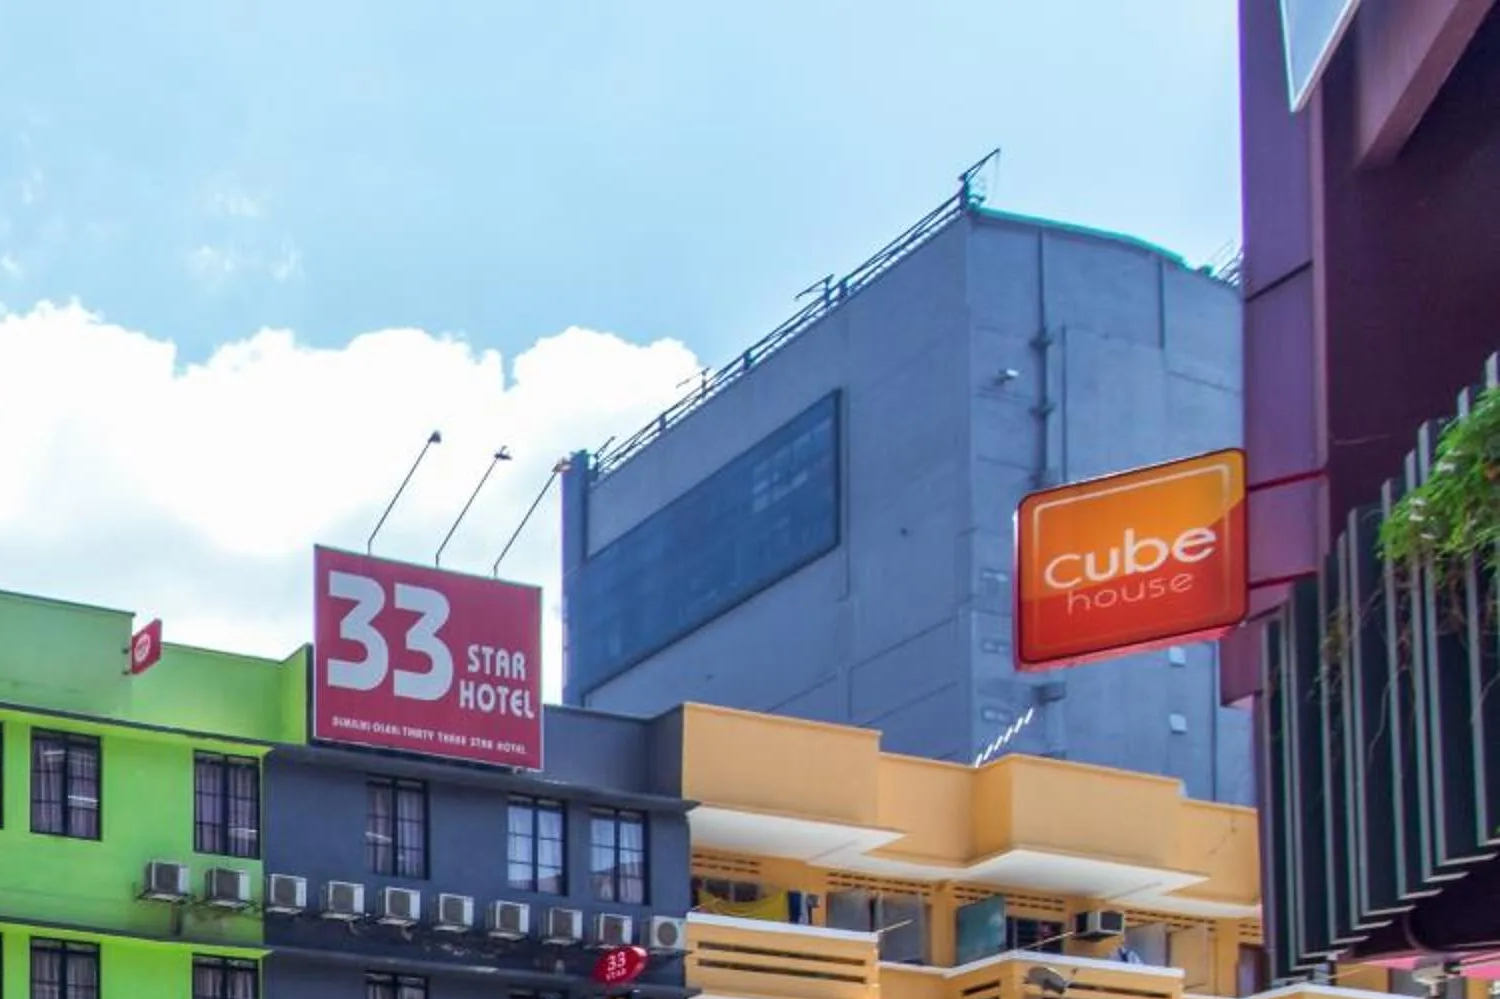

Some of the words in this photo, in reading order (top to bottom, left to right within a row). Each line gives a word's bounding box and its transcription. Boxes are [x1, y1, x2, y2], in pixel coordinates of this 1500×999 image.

[1044, 528, 1217, 589] cube
[1067, 573, 1194, 615] house
[327, 570, 454, 701] 33
[467, 643, 526, 681] STAR
[459, 679, 535, 719] HOTEL
[607, 952, 627, 972] 33
